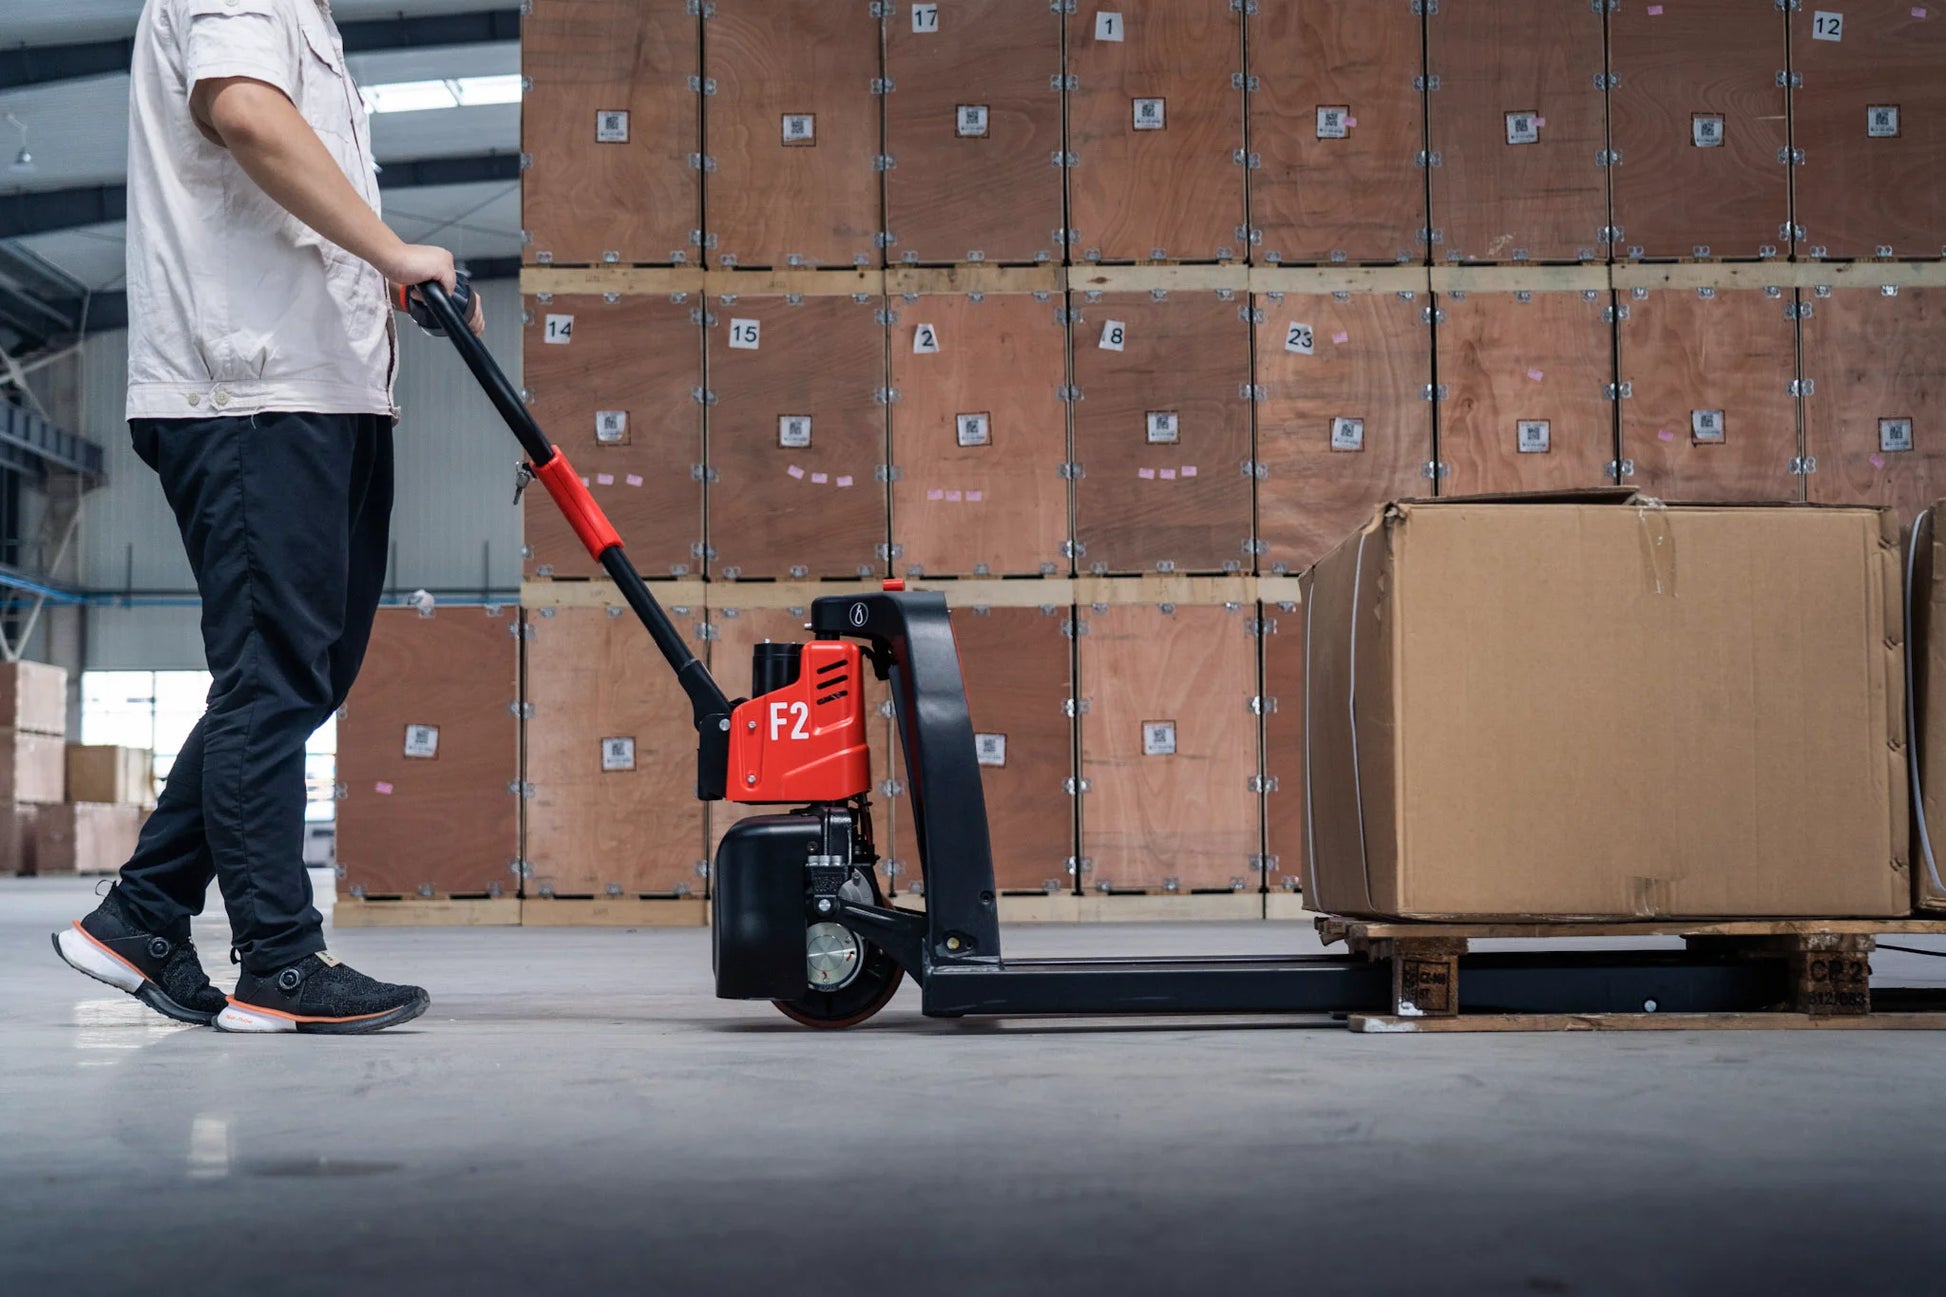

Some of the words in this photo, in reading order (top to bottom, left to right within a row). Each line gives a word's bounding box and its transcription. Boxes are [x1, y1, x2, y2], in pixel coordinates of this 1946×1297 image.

[915, 9, 938, 26] 17
[1105, 18, 1113, 35] 1
[1816, 17, 1840, 36] 12
[549, 321, 571, 338] 14
[734, 325, 757, 342] 15
[921, 329, 934, 347] 2
[1288, 328, 1313, 348] 23
[770, 701, 810, 741] F2
